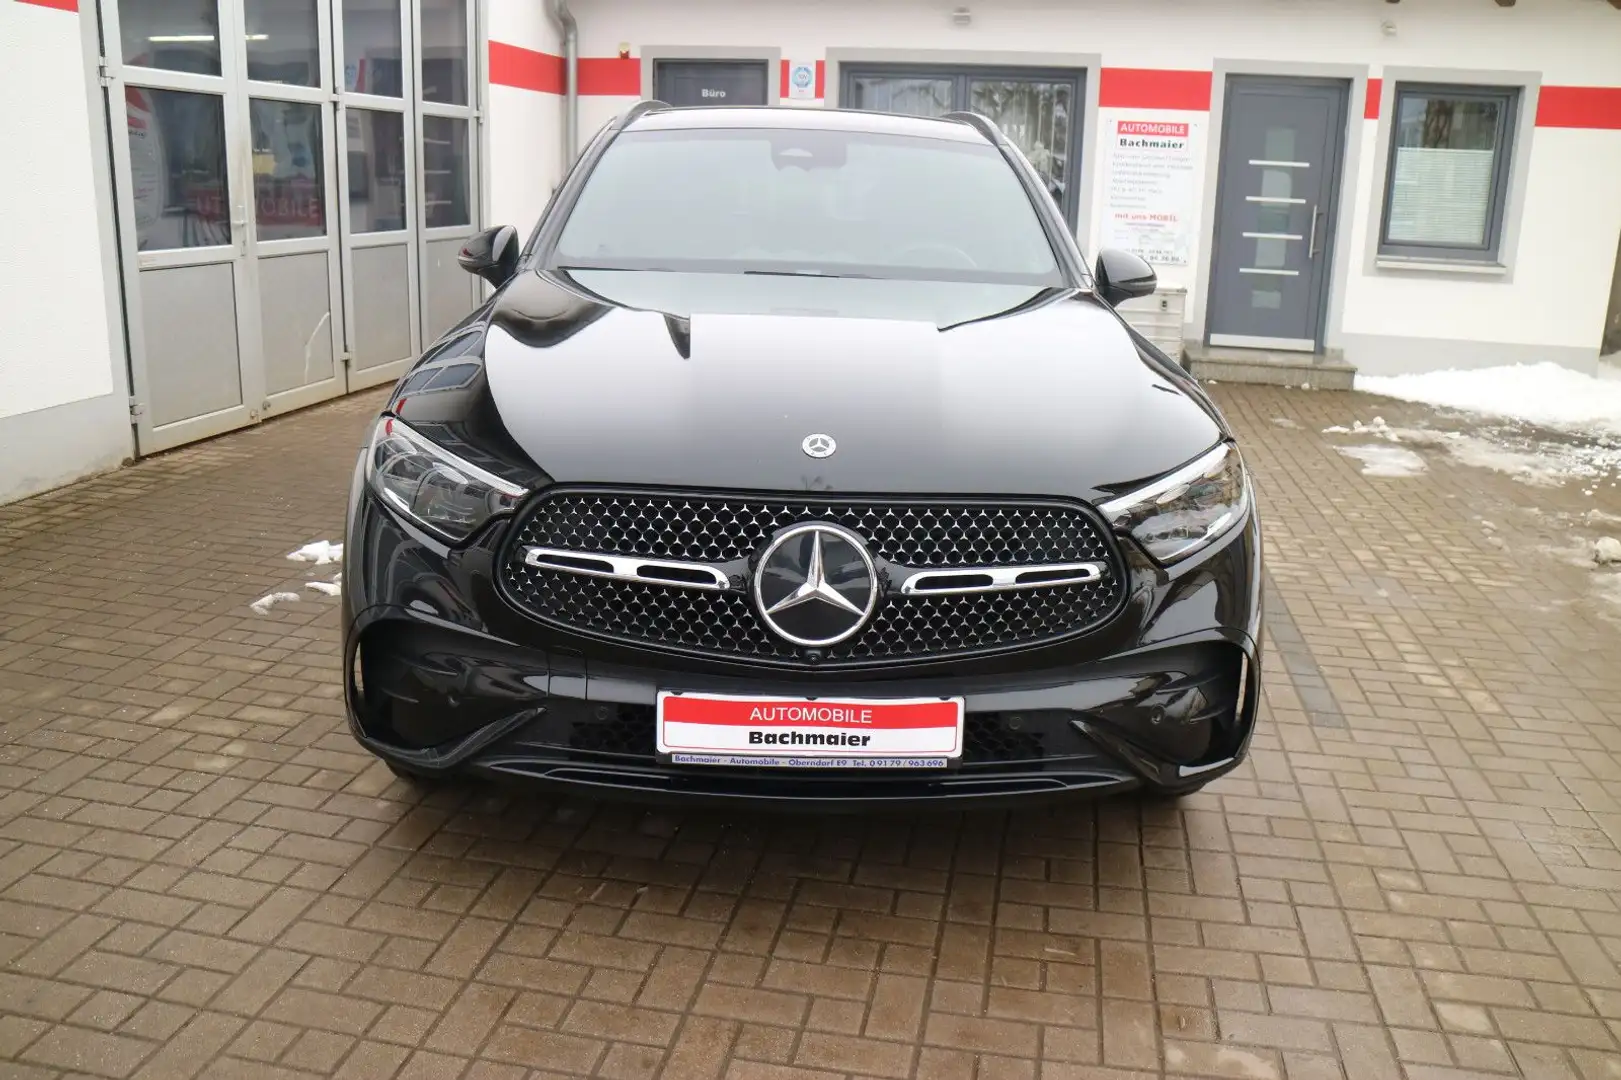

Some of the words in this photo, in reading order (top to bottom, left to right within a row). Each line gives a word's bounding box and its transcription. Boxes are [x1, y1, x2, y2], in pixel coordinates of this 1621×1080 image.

[702, 88, 726, 98] Büro
[1120, 123, 1185, 134] AUTOMOBILE
[1119, 138, 1185, 149] Bachmaier
[1149, 214, 1178, 222] MOBIL
[749, 706, 873, 724] AUTOMOBILE
[748, 731, 871, 747] Bachmaier
[674, 754, 721, 764] Bachmaier
[729, 757, 780, 766] Automobile
[788, 758, 833, 767] Oberndorf
[852, 759, 867, 767] Tel.
